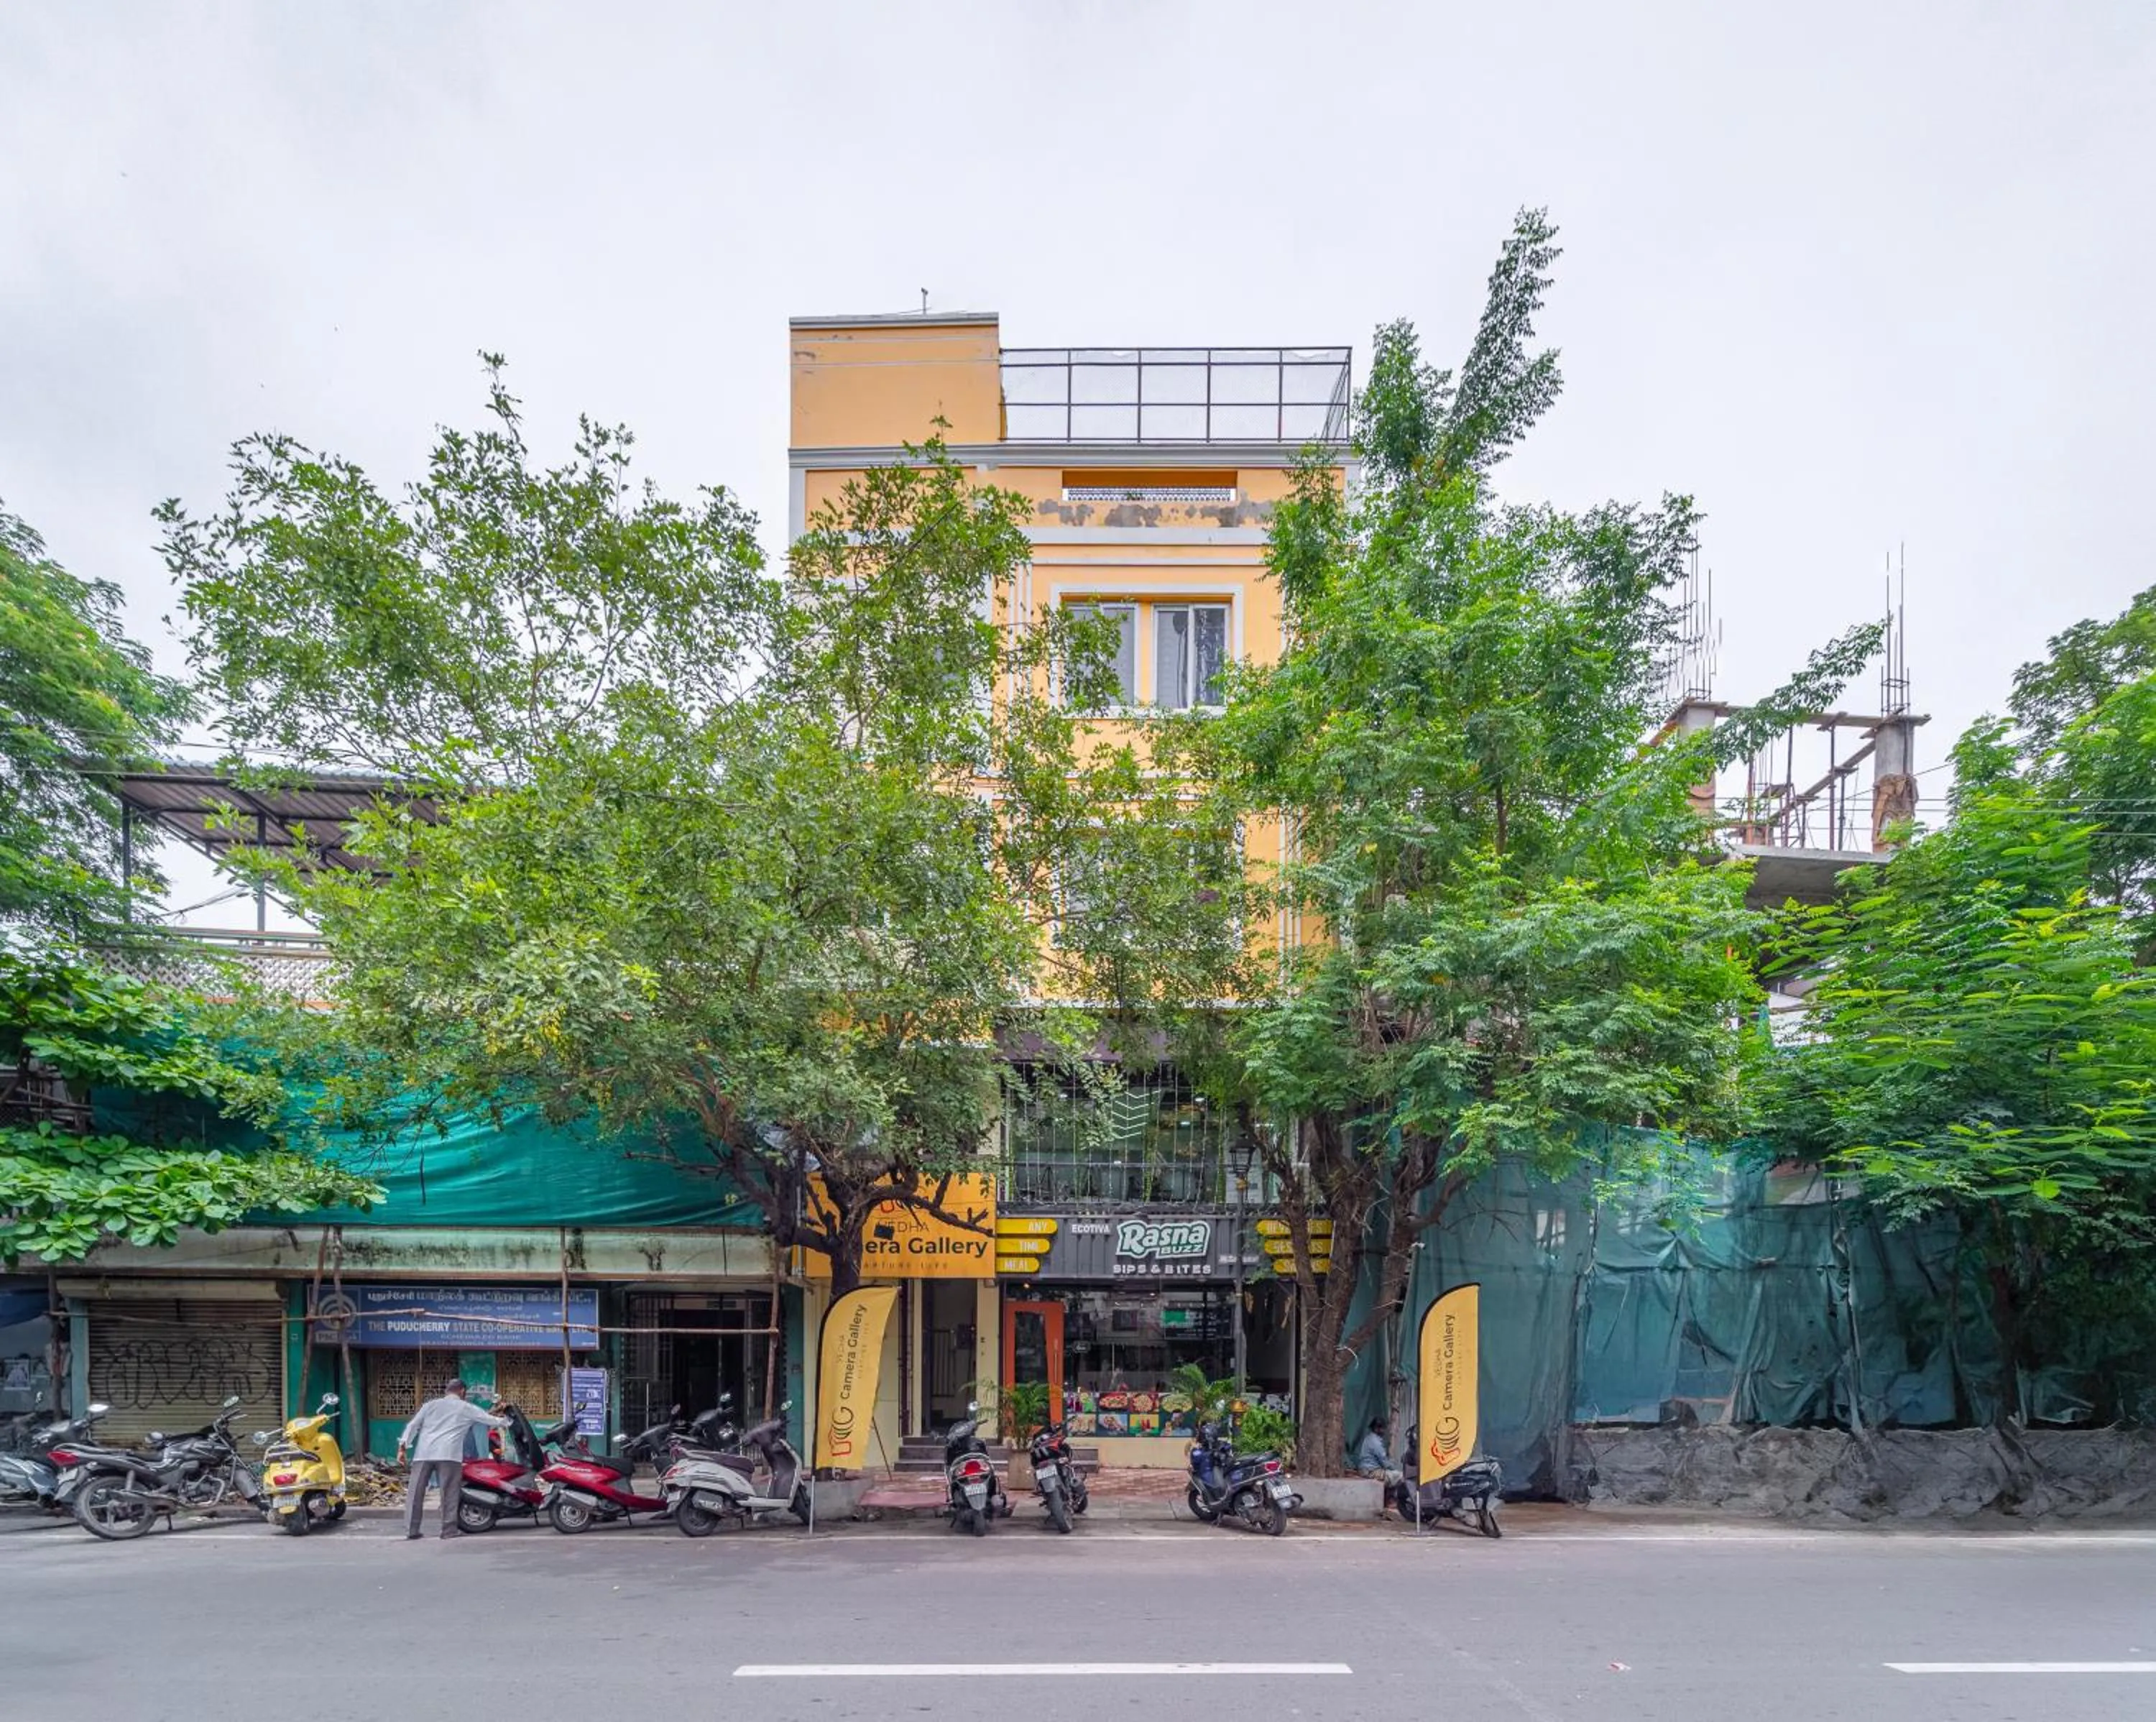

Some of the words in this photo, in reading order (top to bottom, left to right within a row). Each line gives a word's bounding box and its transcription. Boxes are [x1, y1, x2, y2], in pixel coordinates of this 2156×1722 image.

[1028, 1223, 1047, 1232] ANY
[1072, 1224, 1110, 1233] ECOTIVA
[1123, 1224, 1205, 1254] Rasna
[864, 1240, 900, 1254] era
[908, 1237, 988, 1258] Gallery
[1161, 1245, 1204, 1254] BUZZ
[1004, 1261, 1028, 1271] MEAL
[1113, 1264, 1146, 1274] SIPS
[1151, 1264, 1161, 1274] &
[1165, 1264, 1211, 1274] BITES
[368, 1321, 386, 1331] THE
[387, 1321, 451, 1332] PUDUCHERRY
[453, 1322, 479, 1332] STATE
[847, 1304, 867, 1348] Gallery
[1443, 1314, 1455, 1358] Gallery
[840, 1352, 856, 1399] Camera
[1443, 1361, 1454, 1411] Camera
